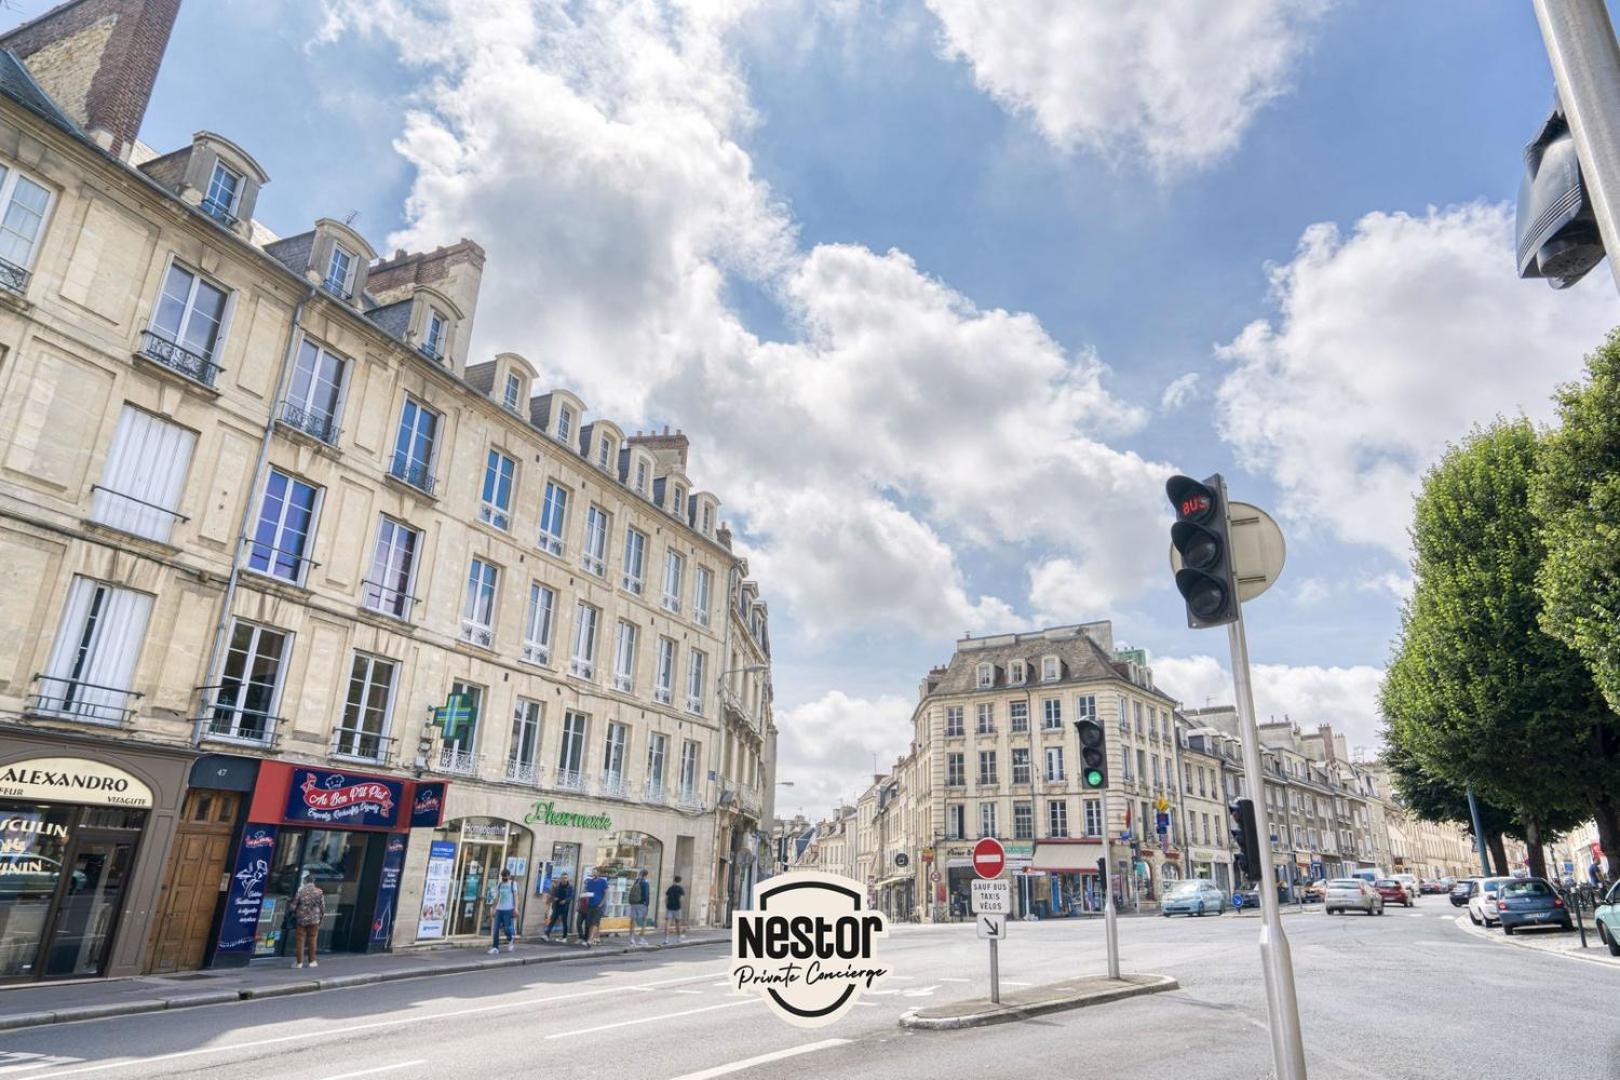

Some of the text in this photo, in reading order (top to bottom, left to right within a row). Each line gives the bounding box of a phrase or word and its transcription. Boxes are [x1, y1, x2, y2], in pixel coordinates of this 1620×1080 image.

[1182, 493, 1209, 515] BUS
[216, 768, 228, 777] 47
[0, 768, 129, 793] ALEXANDRO
[309, 794, 327, 806] Au
[330, 792, 347, 806] Bon
[369, 785, 388, 799] Plat
[524, 800, 613, 830] Pharmacie
[973, 882, 1007, 891] SAUF BUS
[980, 892, 1001, 900] TAXIS
[979, 901, 1002, 910] VÉLOS
